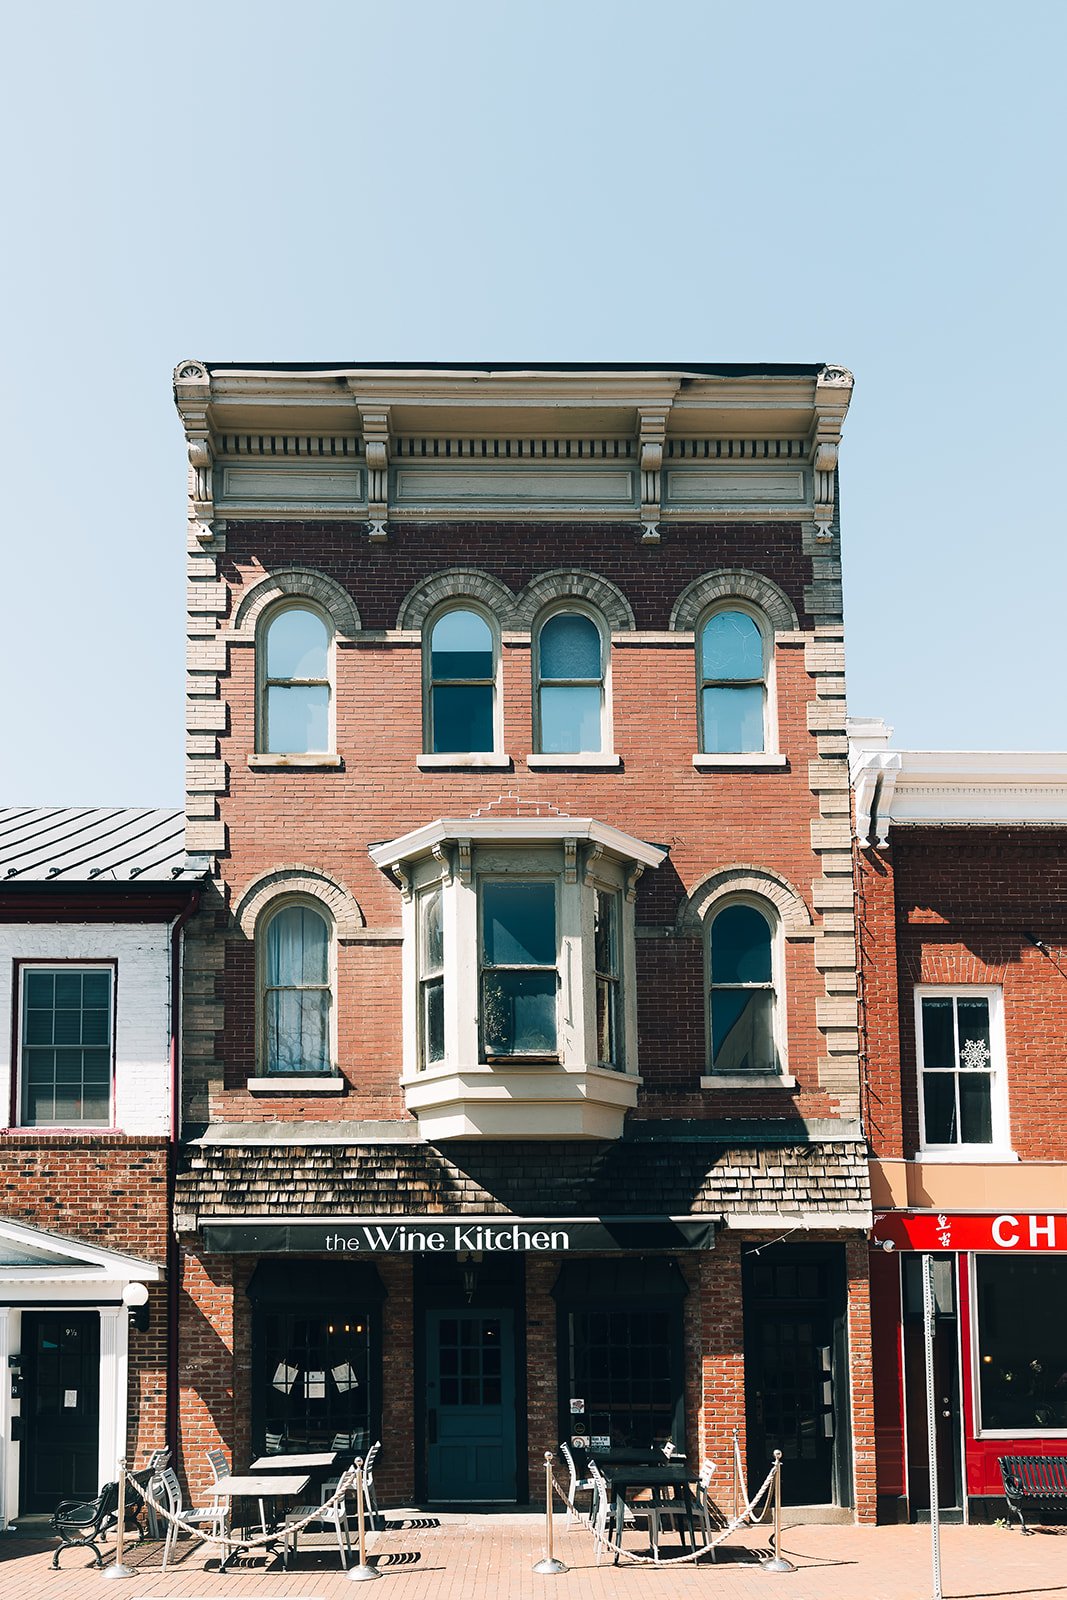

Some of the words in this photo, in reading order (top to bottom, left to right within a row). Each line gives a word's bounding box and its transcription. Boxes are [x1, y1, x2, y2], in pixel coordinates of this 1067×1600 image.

[325, 1233, 360, 1251] the
[362, 1226, 445, 1251] Wine
[455, 1225, 569, 1251] Kitchen
[466, 1291, 473, 1304] 7
